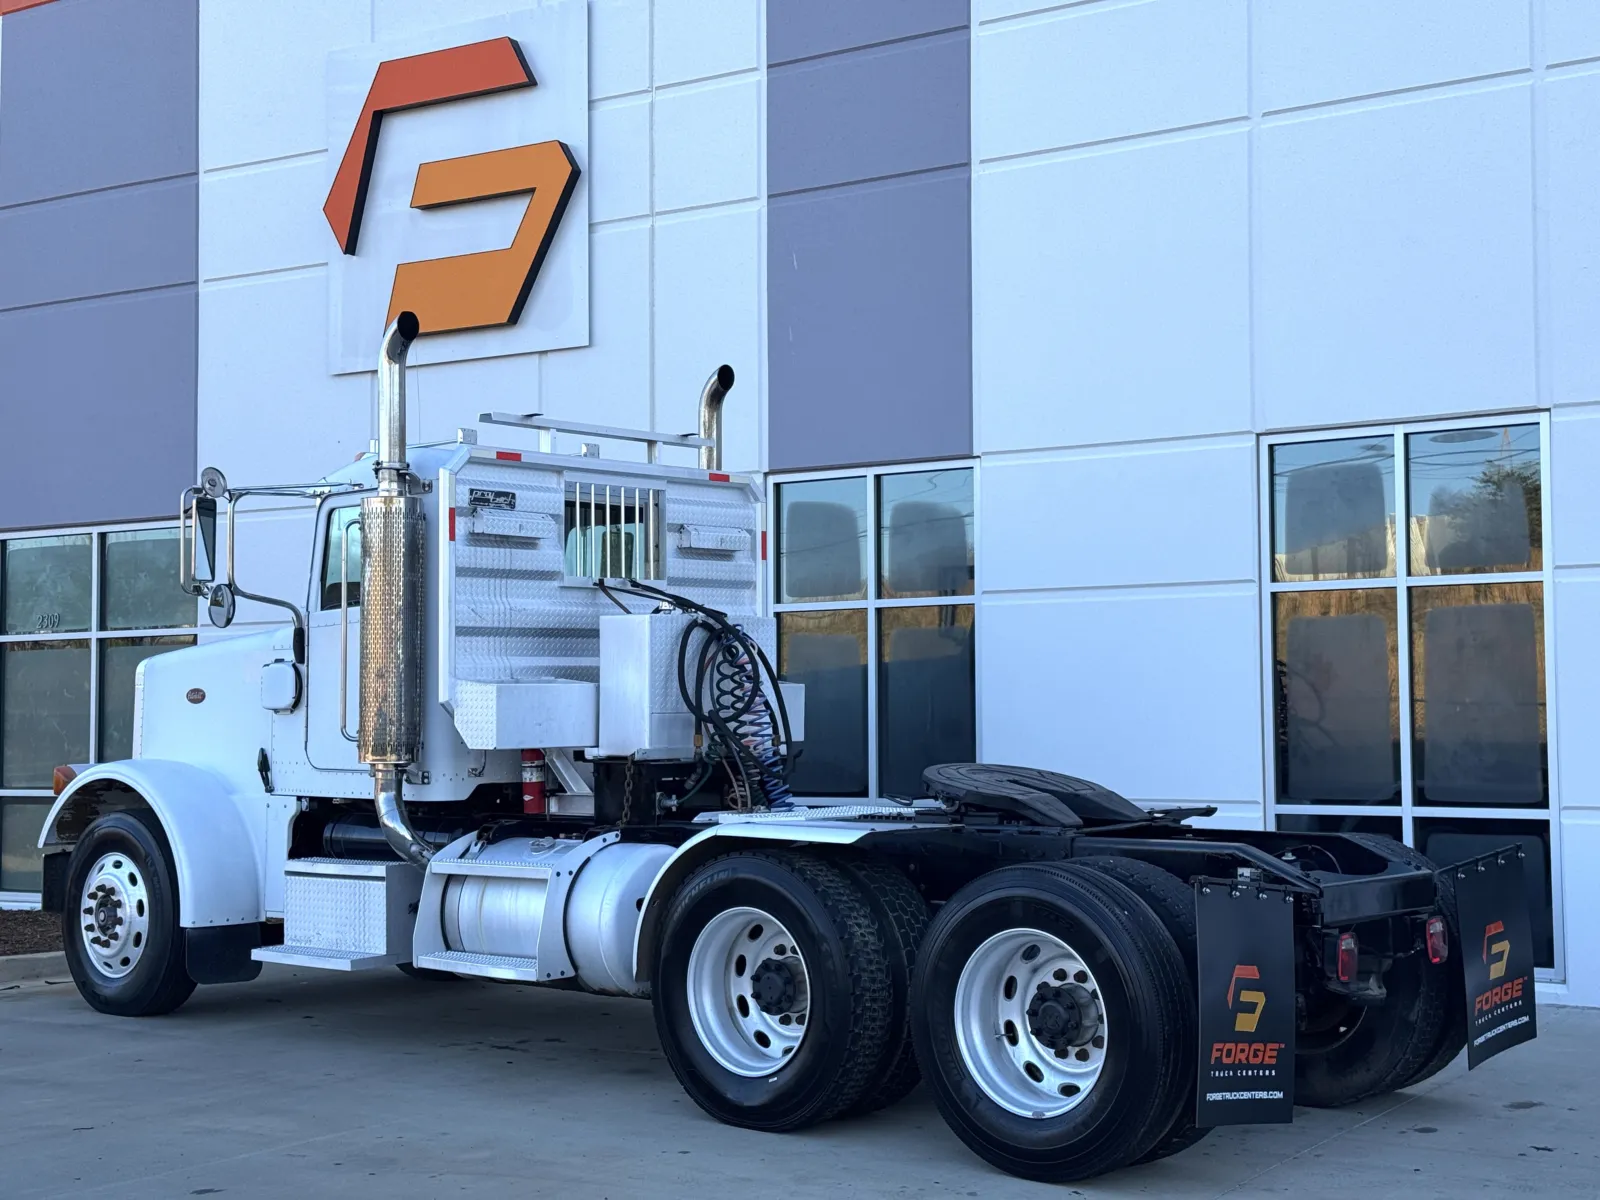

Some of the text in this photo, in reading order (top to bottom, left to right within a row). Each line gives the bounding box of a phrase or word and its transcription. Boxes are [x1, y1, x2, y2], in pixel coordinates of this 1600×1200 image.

[36, 612, 60, 629] 2309
[1475, 977, 1524, 1017] FORGE
[1210, 1042, 1280, 1065] FORGE
[1237, 1069, 1276, 1077] CENTERS
[1206, 1091, 1284, 1101] FORGETRUCKCENTERS.COM
